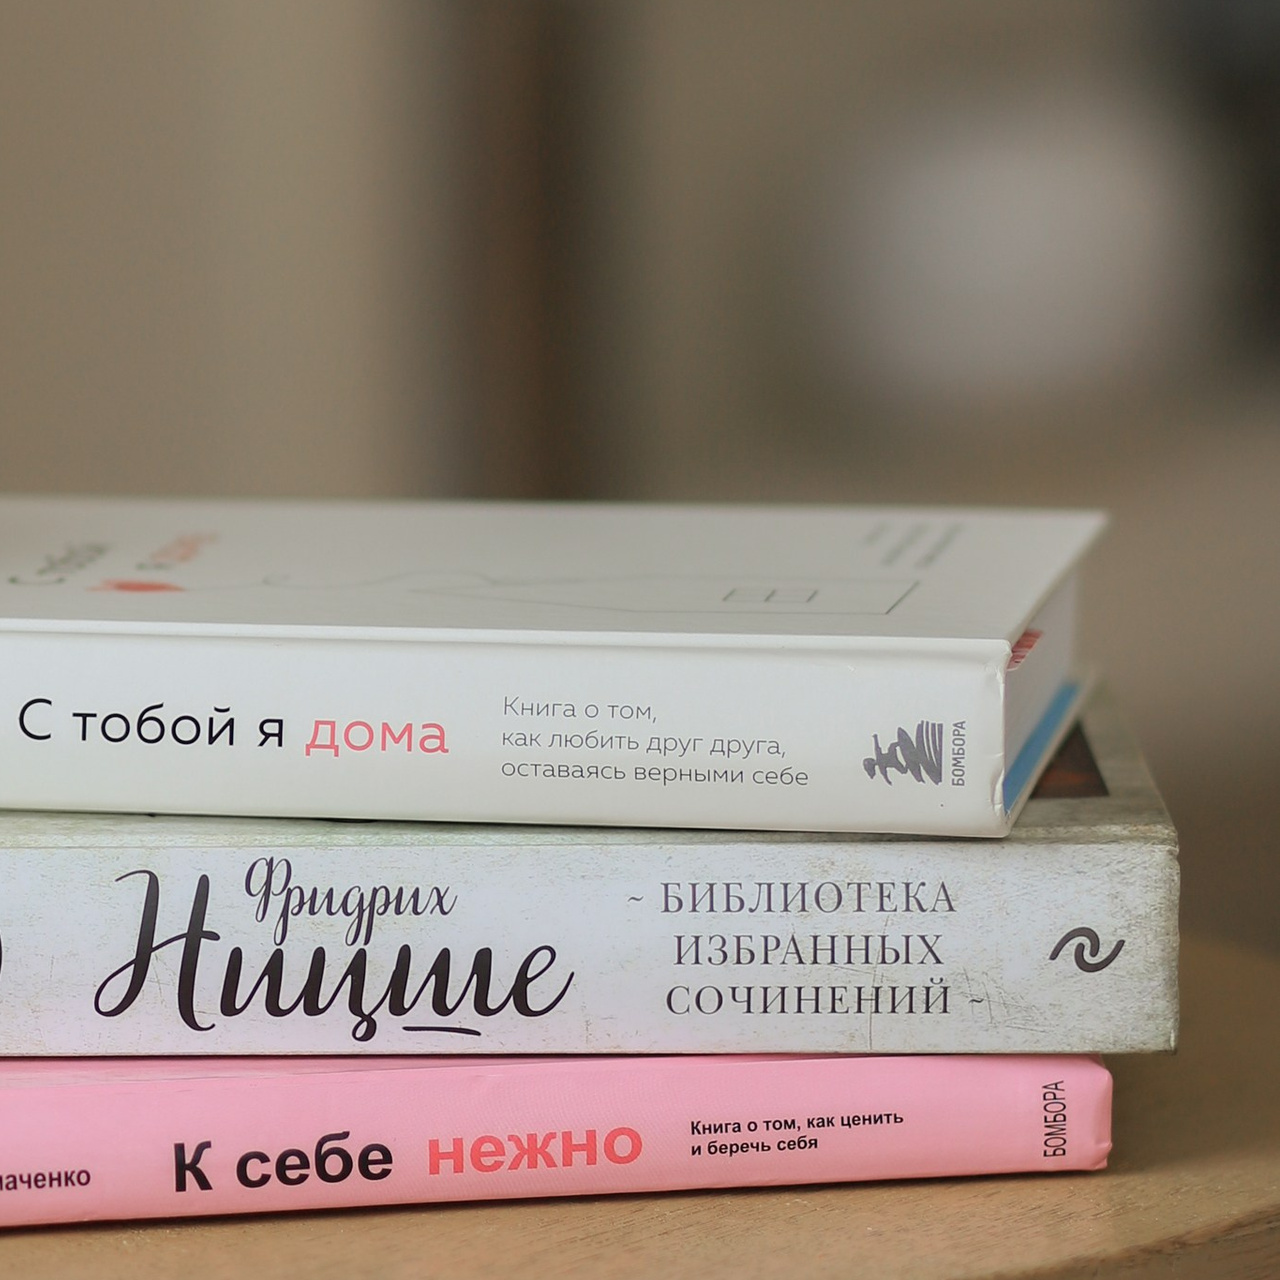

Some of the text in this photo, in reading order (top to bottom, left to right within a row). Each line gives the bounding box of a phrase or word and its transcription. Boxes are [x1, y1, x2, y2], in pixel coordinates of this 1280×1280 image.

[18, 697, 449, 757] С тобой я дома
[504, 696, 658, 724] Книга о том,
[501, 729, 786, 758] как любить друг друга,
[951, 720, 967, 787] БОМБОРА
[501, 761, 809, 786] оставаясь верными себе
[245, 856, 458, 946] Фридрих
[660, 881, 957, 913] БИБЛИОТЕКА
[94, 869, 574, 1041] Ницше
[673, 933, 944, 966] ИЗБРАННЫХ
[665, 977, 951, 1016] СОЧИНЕНИЙ
[690, 1111, 904, 1136] Книга о том, как ценить
[1042, 1080, 1067, 1158] БОМБОРА
[174, 1126, 643, 1193] К себе нежно
[690, 1135, 818, 1159] и беречь себя
